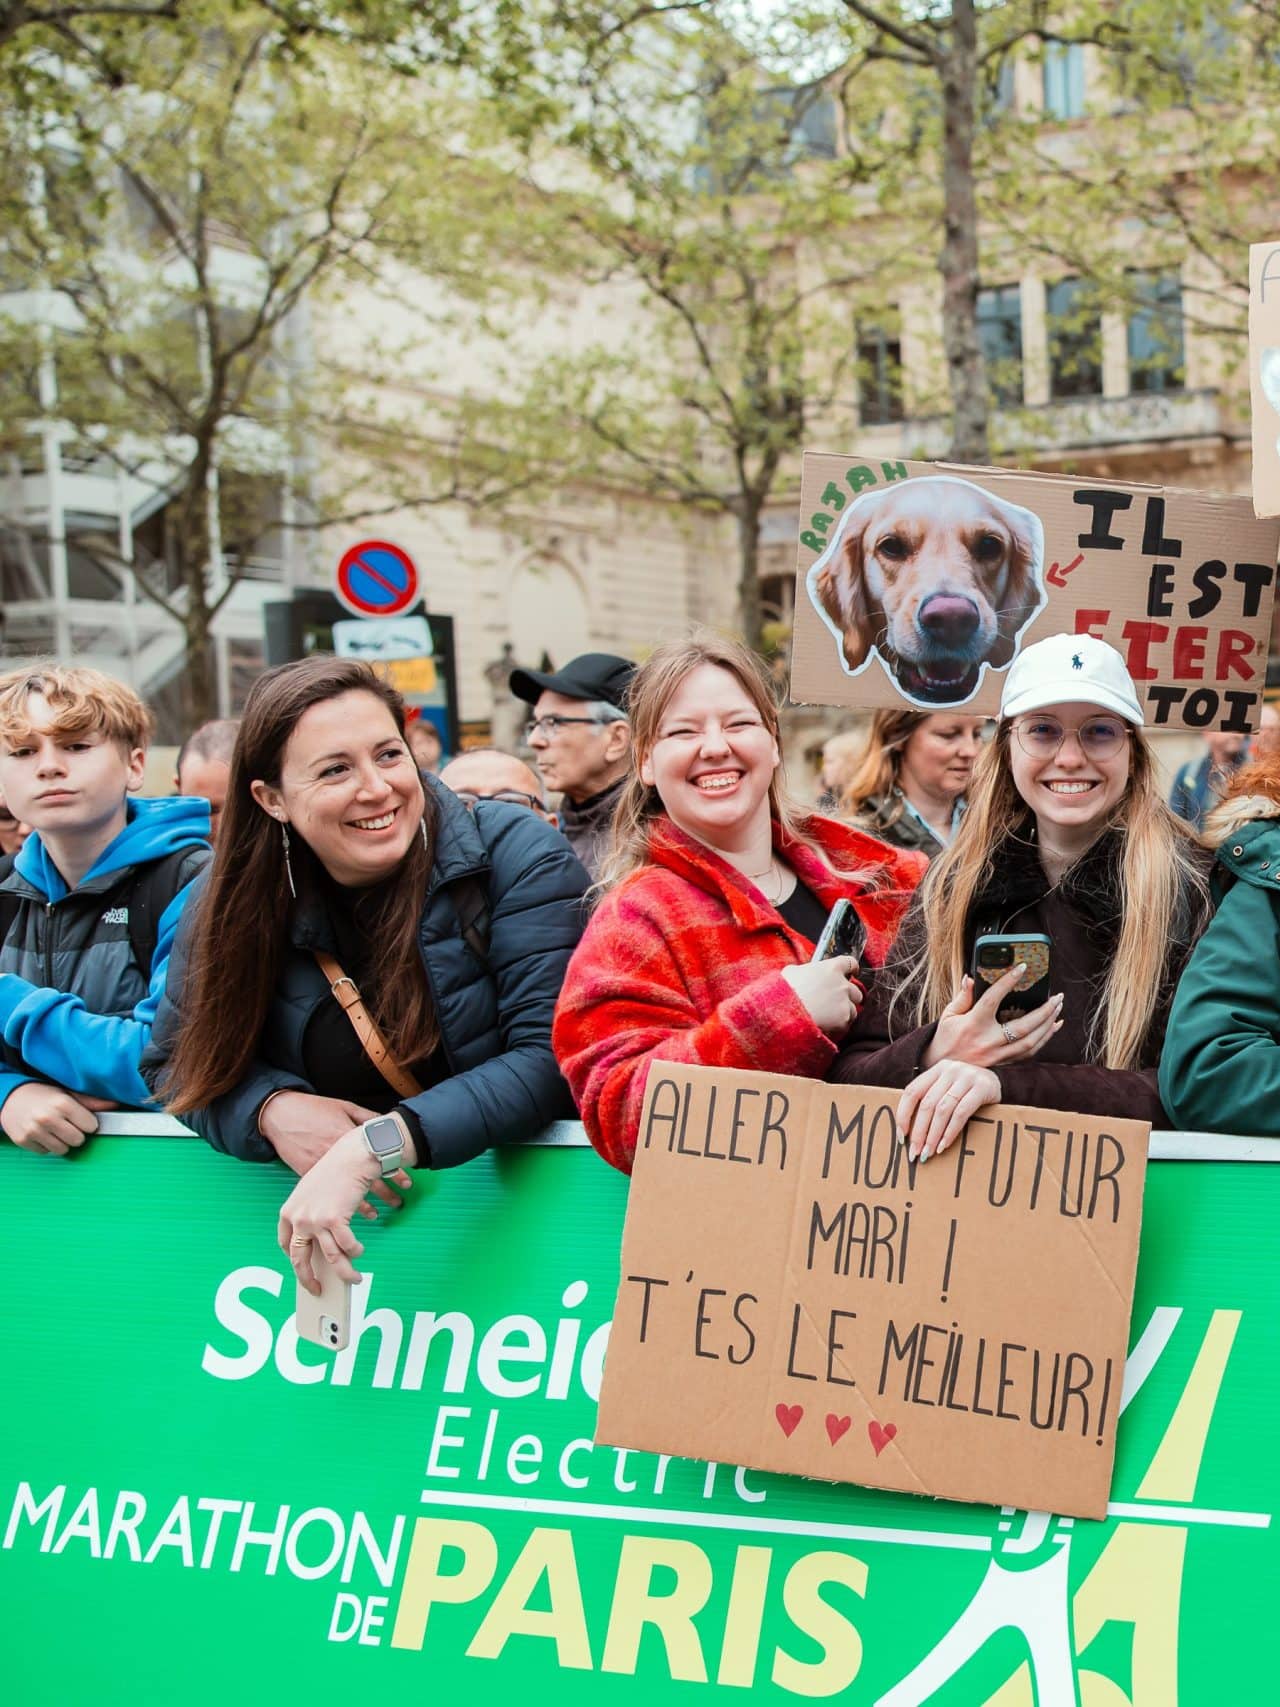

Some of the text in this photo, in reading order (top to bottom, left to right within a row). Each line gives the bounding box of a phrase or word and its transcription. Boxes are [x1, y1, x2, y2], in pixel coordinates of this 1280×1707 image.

[800, 461, 908, 554] RAJAH
[1072, 490, 1182, 558] IL
[1147, 559, 1274, 619] EST
[1147, 686, 1257, 733] TOI
[644, 1079, 790, 1170] ALLER
[953, 1115, 1125, 1223] FUTUR
[787, 1304, 856, 1388] LE
[424, 1405, 768, 1503] Electric
[2, 1481, 406, 1588] MARATHON
[327, 1517, 871, 1698] DE PARIS
